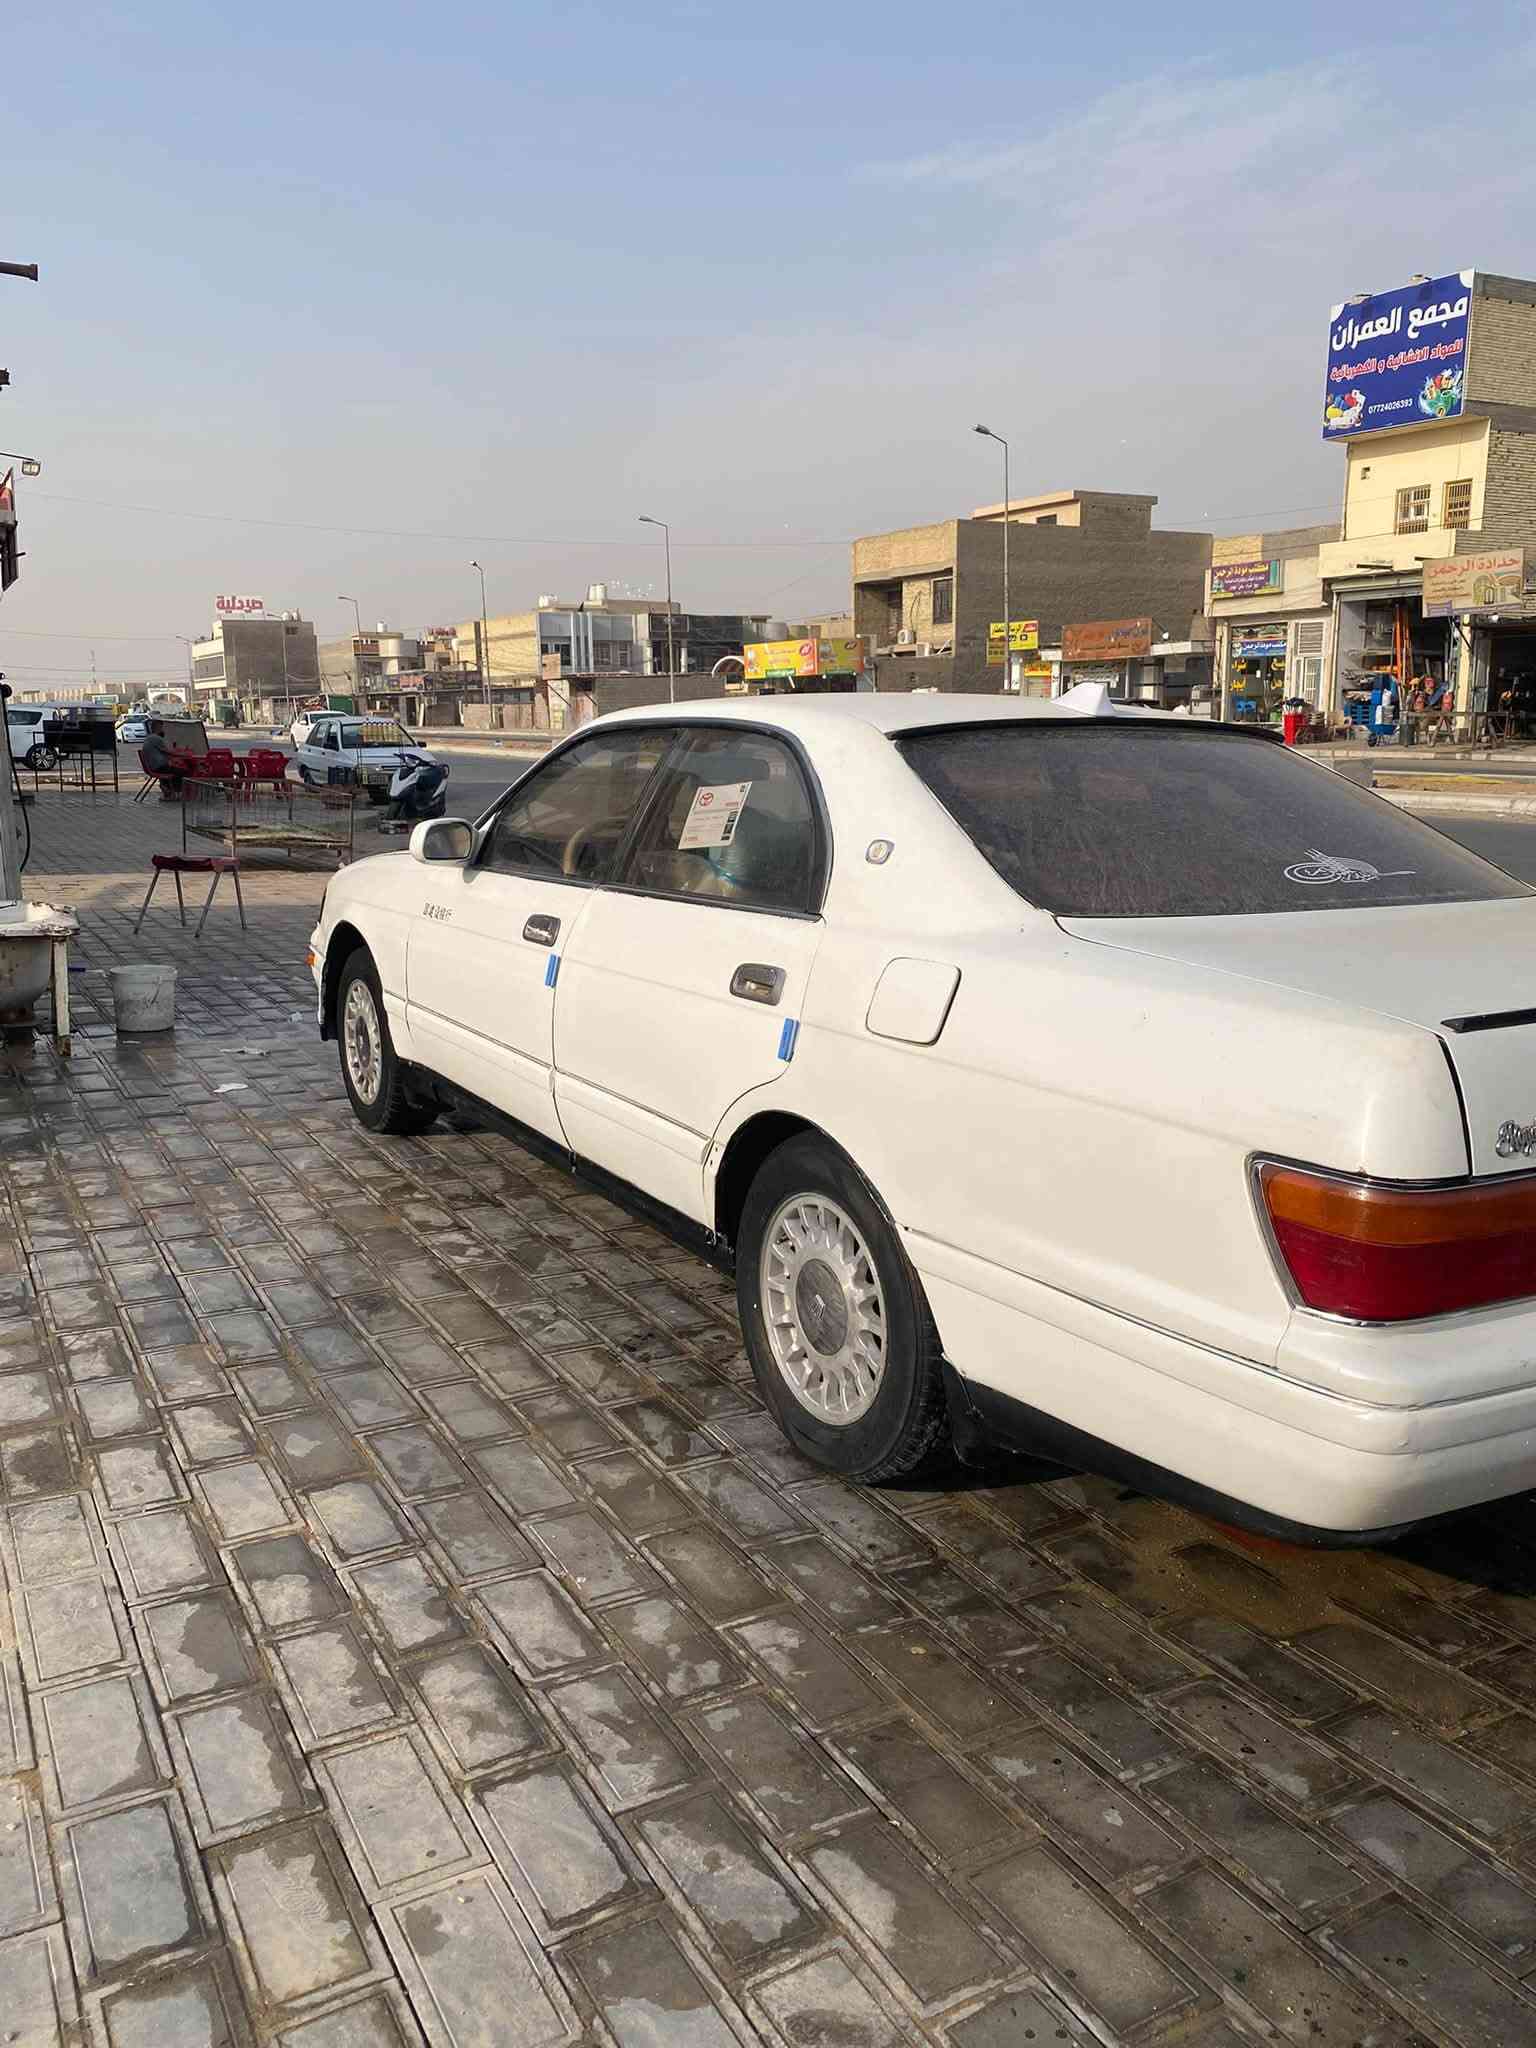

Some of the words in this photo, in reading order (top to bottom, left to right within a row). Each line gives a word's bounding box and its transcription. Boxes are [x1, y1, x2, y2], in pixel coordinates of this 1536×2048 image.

[1331, 306, 1402, 351] العمران
[1407, 296, 1468, 339] مجمع
[216, 595, 263, 614] صيدلية
